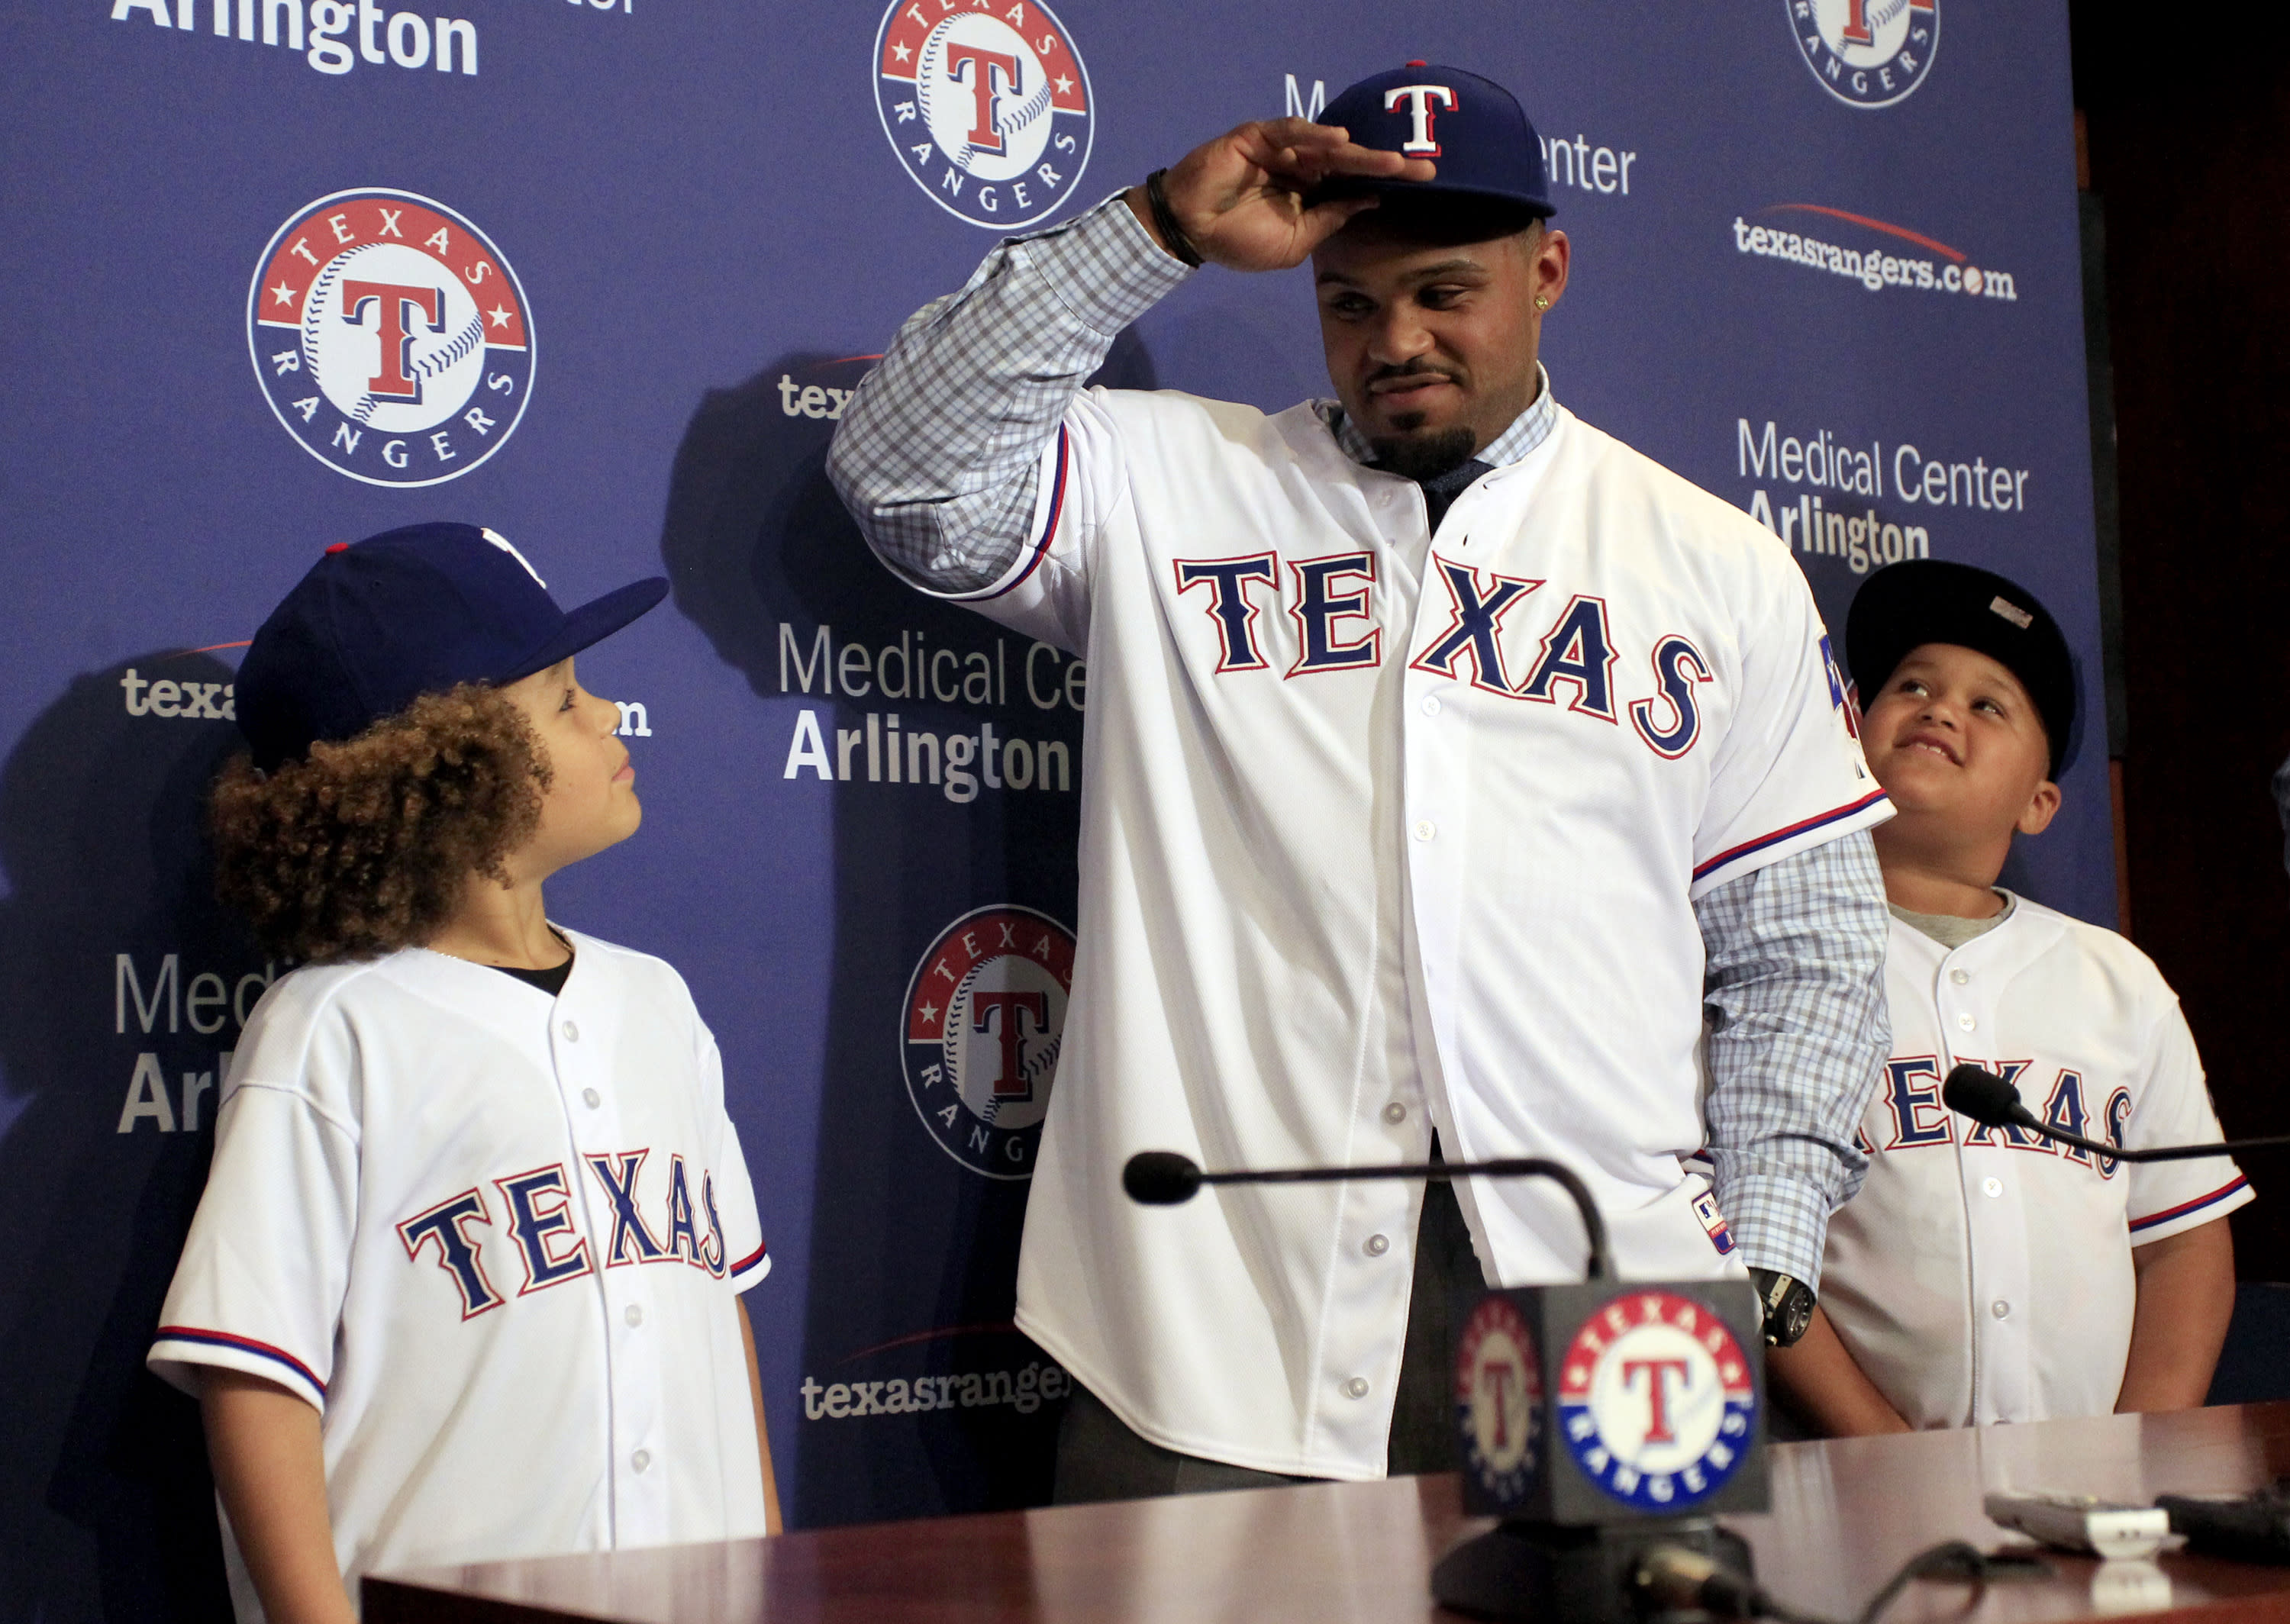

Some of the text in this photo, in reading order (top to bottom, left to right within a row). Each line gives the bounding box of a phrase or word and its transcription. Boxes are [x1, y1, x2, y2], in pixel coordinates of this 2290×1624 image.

[1795, 0, 1928, 95] RANGERS
[894, 101, 1076, 212] RANGERS
[1385, 85, 1459, 157] T
[290, 208, 492, 286] TEXAS
[1734, 217, 2017, 301] texasrangers.com
[272, 348, 514, 469] RANGERS
[1738, 417, 2029, 511] Medical Center
[1750, 489, 1929, 574] Arlington
[779, 623, 1005, 706] Medical
[1172, 550, 1713, 760] TEXAS
[783, 709, 1069, 804] Arlington
[1853, 1054, 2134, 1181] EXAS
[395, 1147, 727, 1323] TEXAS
[1623, 1360, 1690, 1442] T
